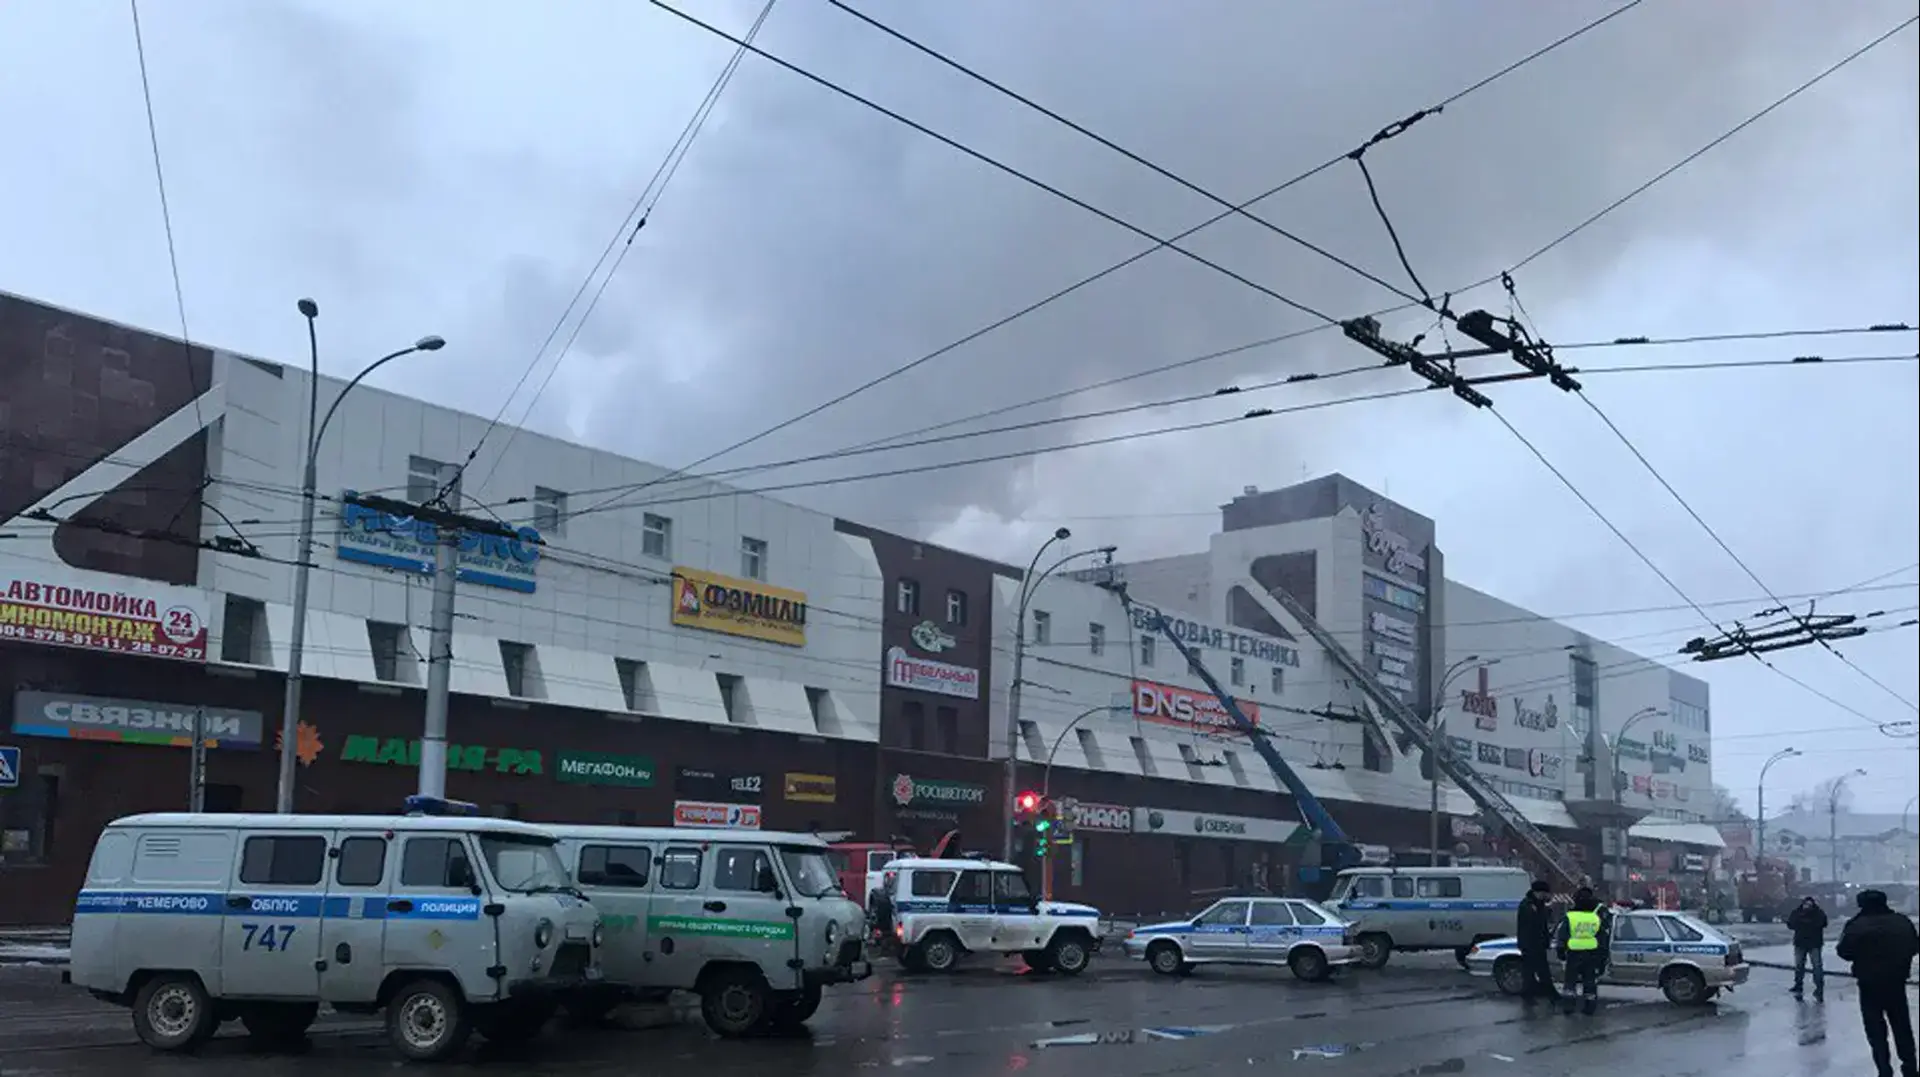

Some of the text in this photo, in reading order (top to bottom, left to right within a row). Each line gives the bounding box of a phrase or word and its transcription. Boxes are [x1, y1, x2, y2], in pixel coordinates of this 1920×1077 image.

[0, 603, 157, 641] ИНОМОНТАЖ
[169, 611, 193, 628] 24
[1225, 632, 1300, 668] ТЕХНИКА
[1138, 687, 1194, 721] DNS
[731, 776, 761, 792] TELE2
[136, 896, 209, 910] КЕМЕРОВО
[251, 898, 299, 912] ОБППС
[420, 902, 477, 915] ПОЛИЦИЯ
[241, 924, 296, 952] 747
